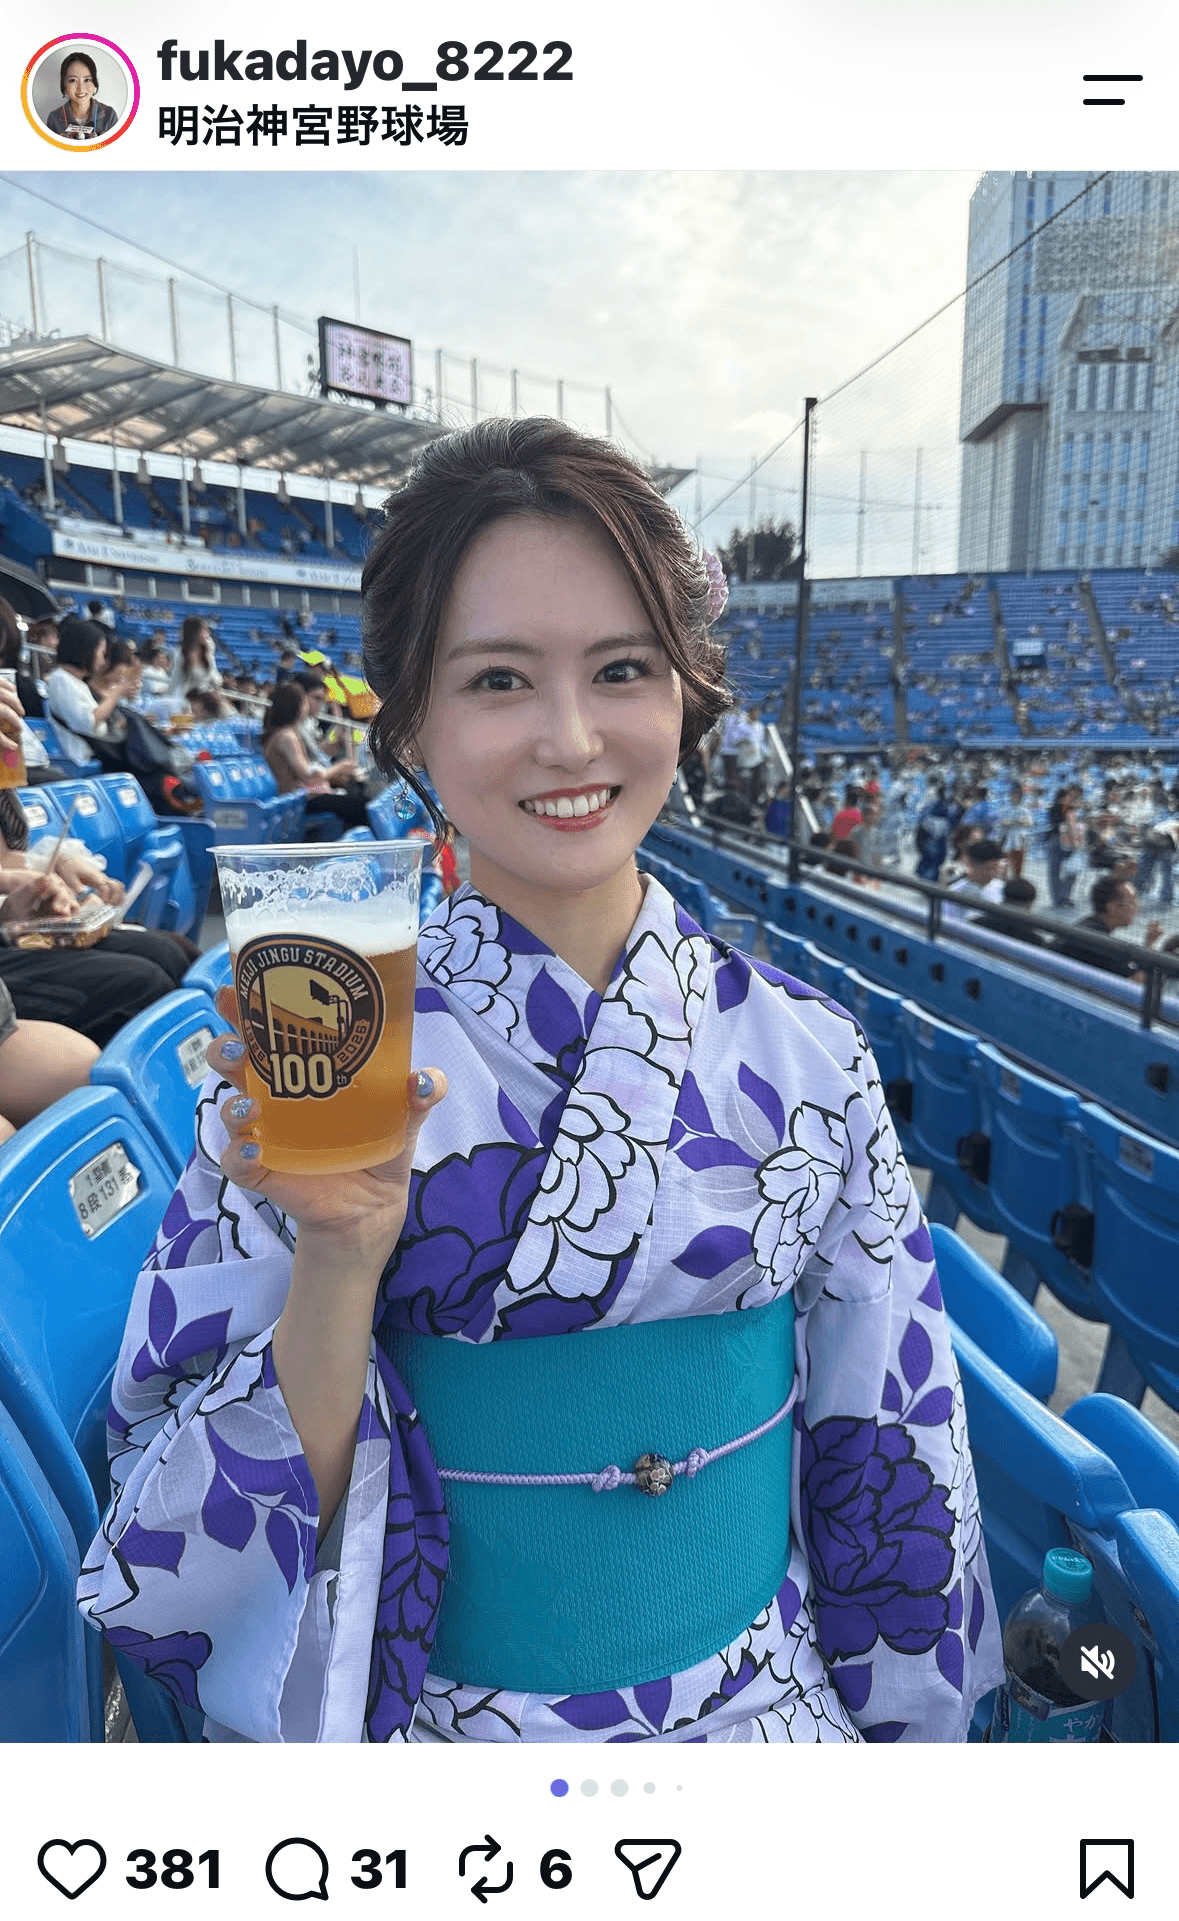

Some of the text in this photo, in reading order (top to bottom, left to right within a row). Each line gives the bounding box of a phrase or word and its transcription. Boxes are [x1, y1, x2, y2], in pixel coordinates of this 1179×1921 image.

[240, 947, 369, 1001] MEIJI JINGU STADIUM
[337, 1023, 368, 1063] 2026
